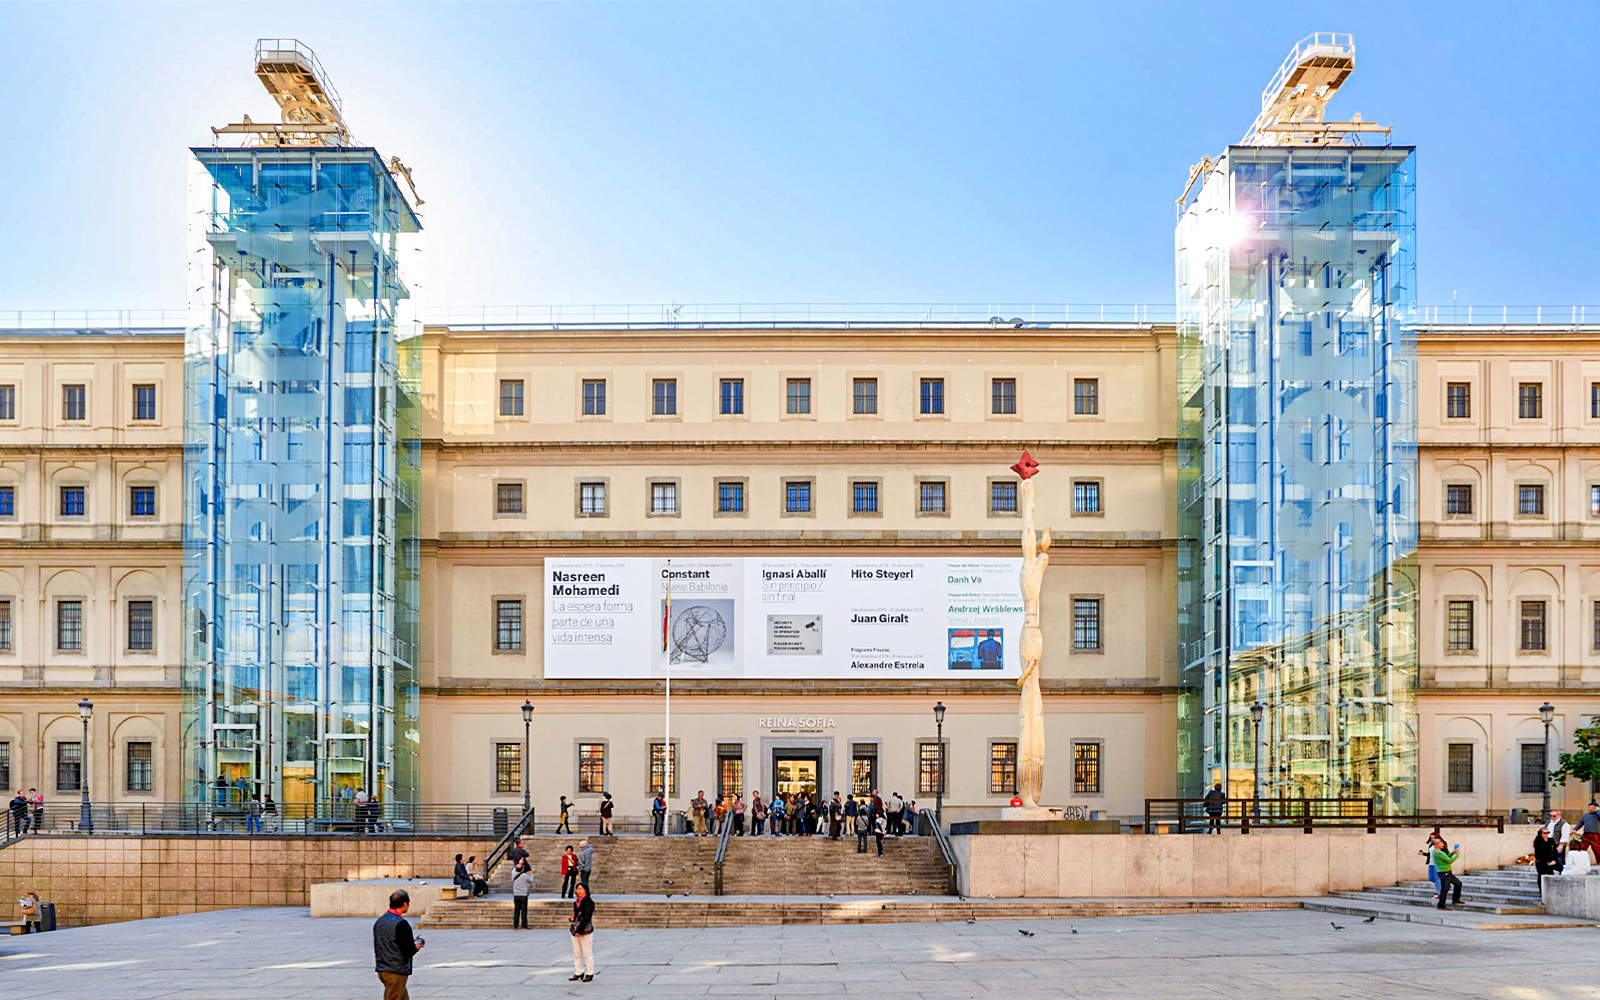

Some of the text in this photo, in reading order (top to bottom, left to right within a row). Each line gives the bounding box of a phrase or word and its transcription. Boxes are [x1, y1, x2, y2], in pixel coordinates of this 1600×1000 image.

[553, 571, 605, 582] Nasreen
[661, 569, 710, 578] Constant
[762, 569, 827, 580] Ignasi Aballí
[851, 569, 913, 580] Hito Steyerl
[552, 584, 620, 595] Mohamedi
[689, 581, 728, 591] Babilonia
[762, 580, 776, 590] Sin
[762, 592, 775, 600] sin
[552, 600, 633, 614] La espera forma
[948, 605, 980, 614] Andrzej
[552, 616, 615, 629] parte de una
[851, 614, 909, 623] Juan Giralt
[552, 632, 612, 642] vida intensa
[851, 661, 925, 669] Alexandre Estrela
[759, 718, 836, 727] REINA SOFIA
